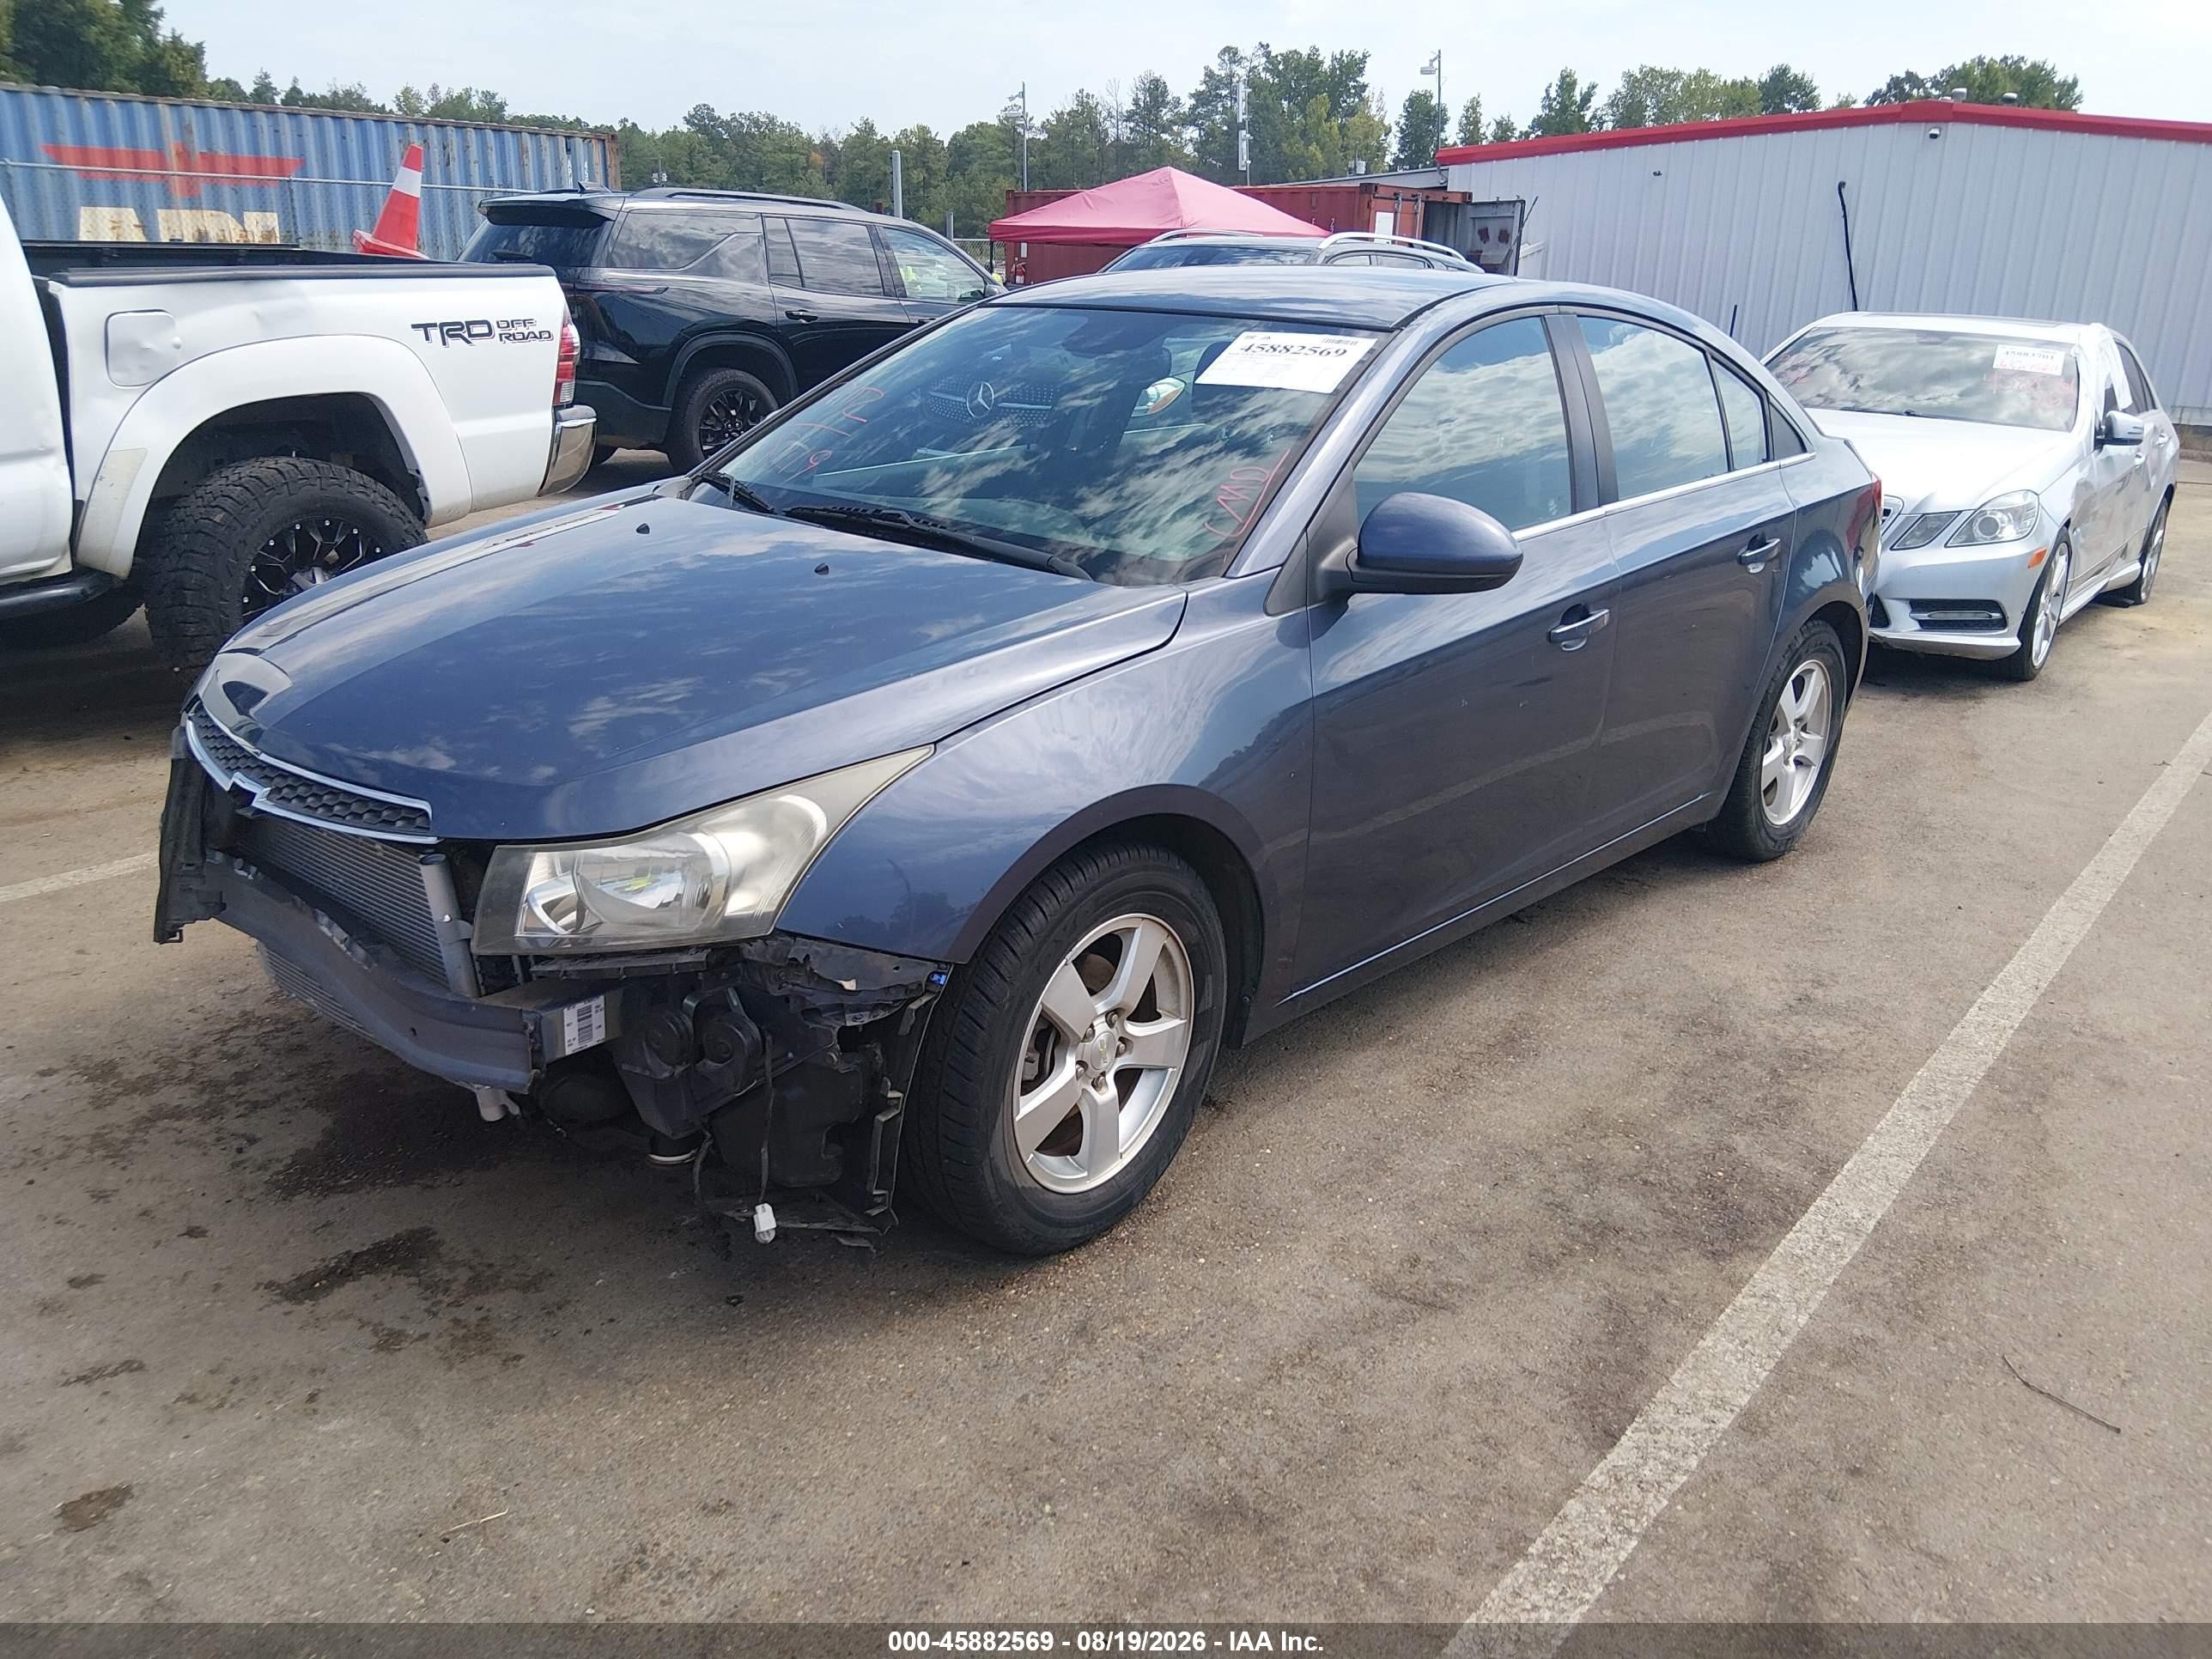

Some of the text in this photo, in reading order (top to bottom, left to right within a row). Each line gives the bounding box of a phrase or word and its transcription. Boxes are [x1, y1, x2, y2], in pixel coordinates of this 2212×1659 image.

[496, 319, 537, 331] OFF
[411, 319, 495, 347] TRD
[499, 331, 554, 343] ROAD
[1240, 343, 1347, 357] 45882569
